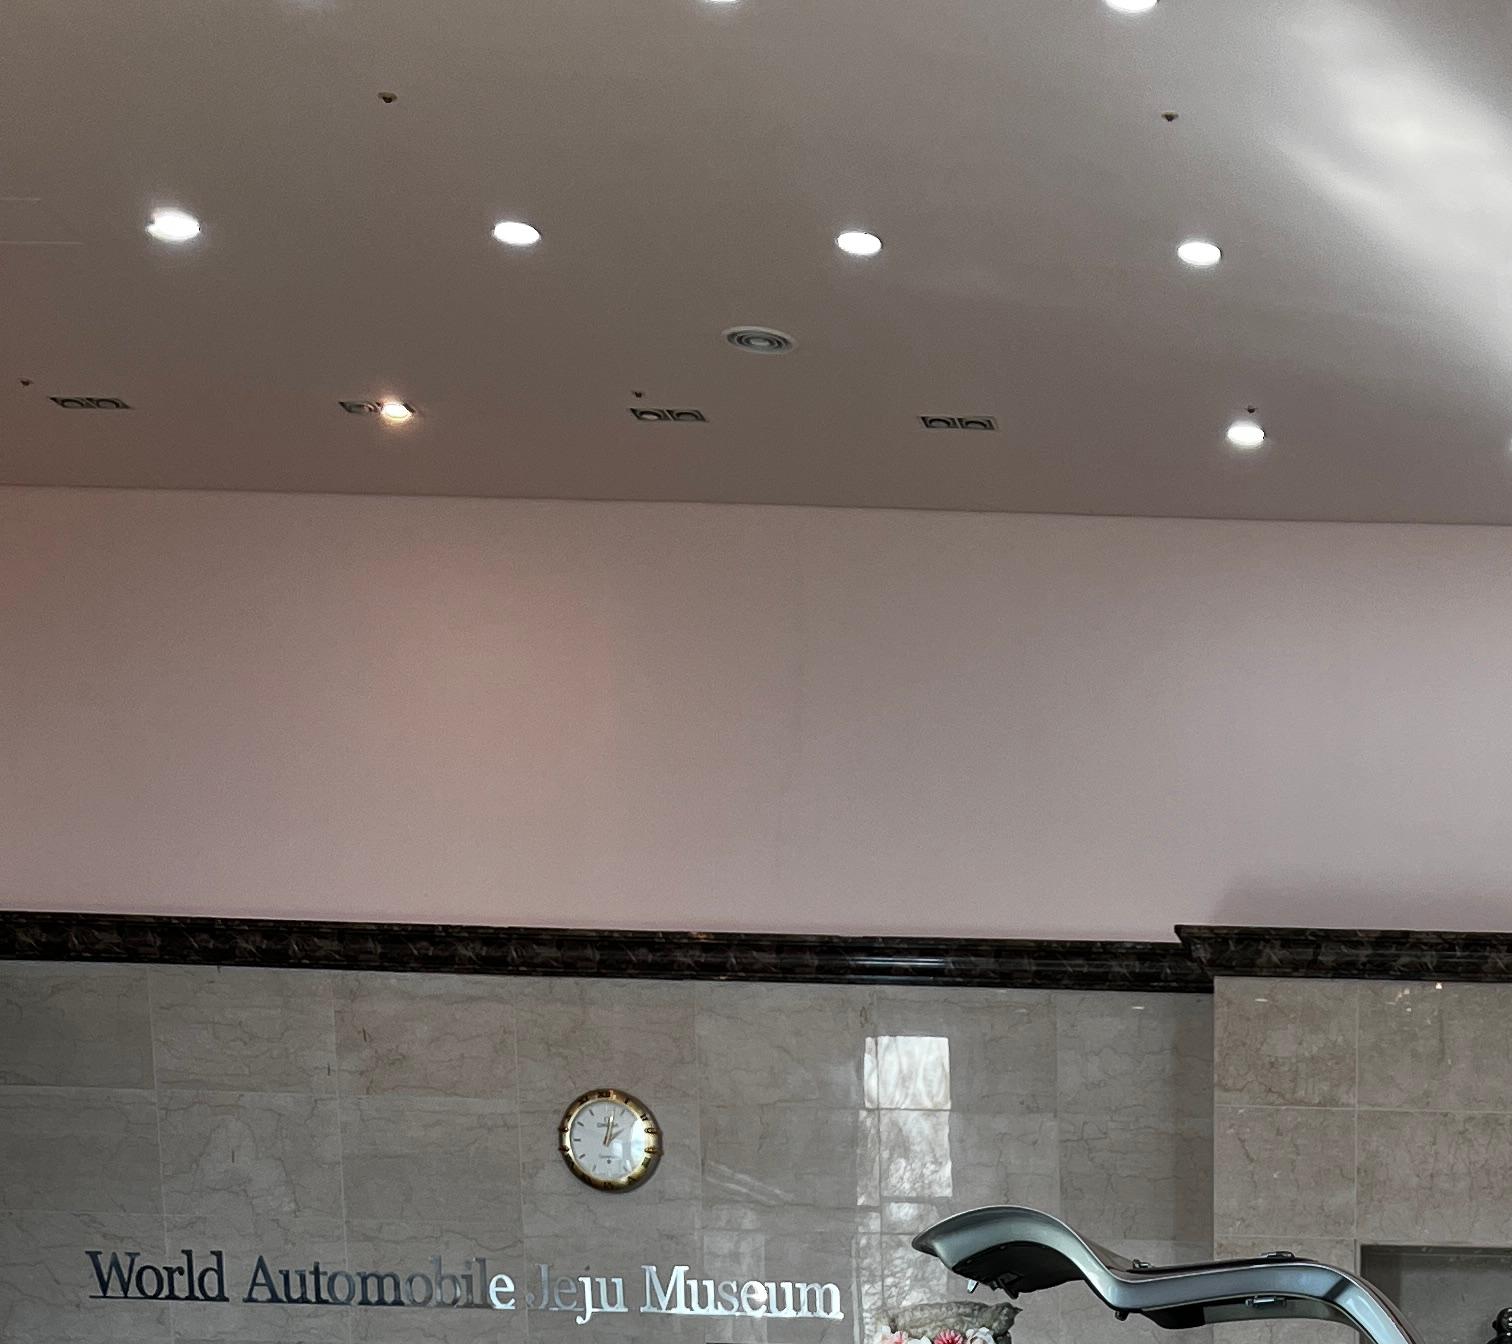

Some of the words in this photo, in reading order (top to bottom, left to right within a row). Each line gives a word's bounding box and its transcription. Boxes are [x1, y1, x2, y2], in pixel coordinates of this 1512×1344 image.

[85, 1249, 229, 1302] World
[242, 1254, 516, 1309] Automobile
[525, 1263, 629, 1324] Jeju
[640, 1265, 844, 1320] Museum
